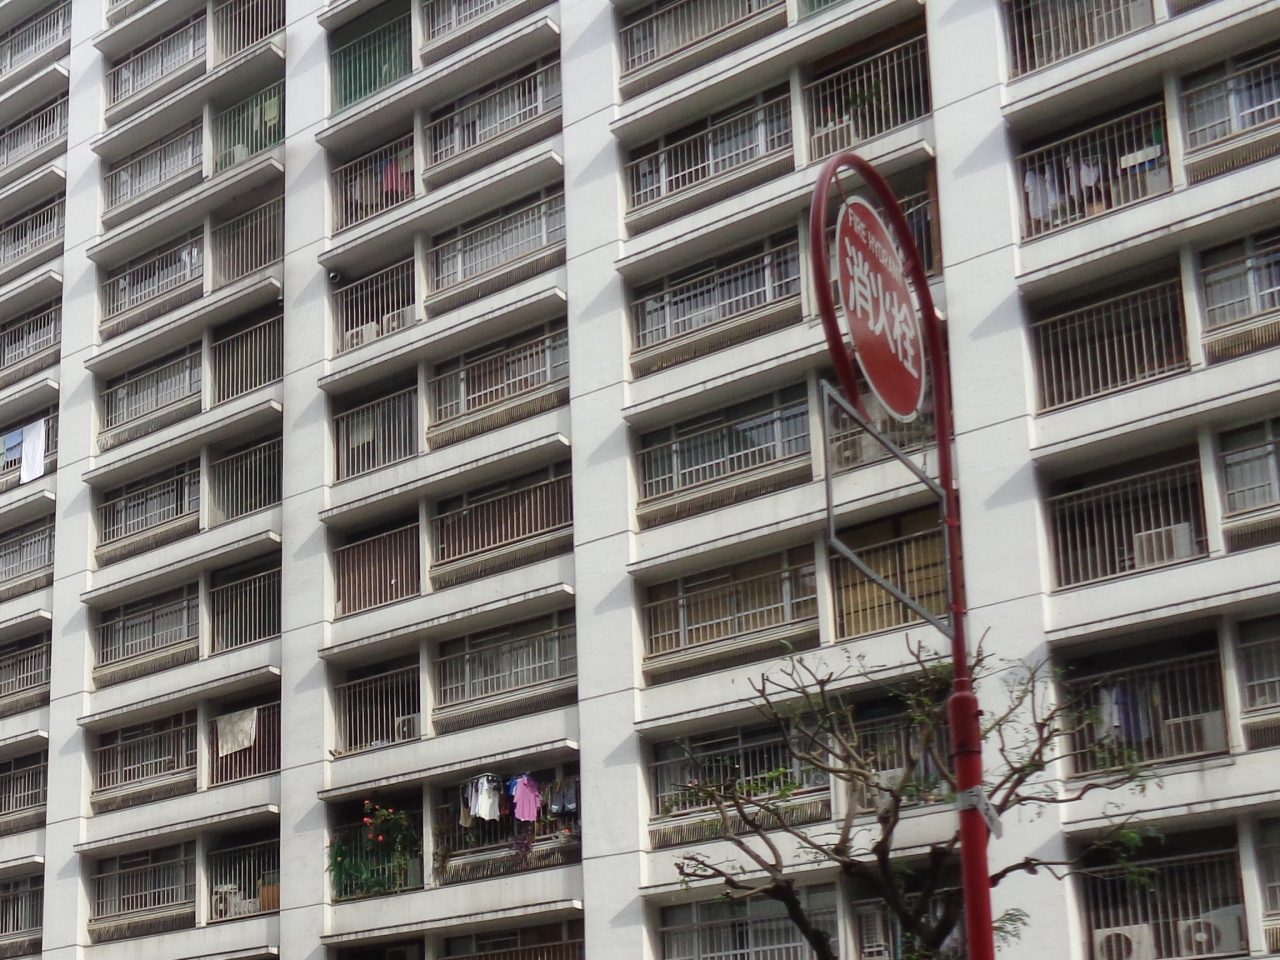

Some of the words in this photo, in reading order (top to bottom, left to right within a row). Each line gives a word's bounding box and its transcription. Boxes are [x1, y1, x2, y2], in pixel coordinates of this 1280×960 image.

[848, 209, 867, 244] FIRE
[867, 231, 901, 287] HYDRANT
[844, 236, 918, 379] 消火栓
